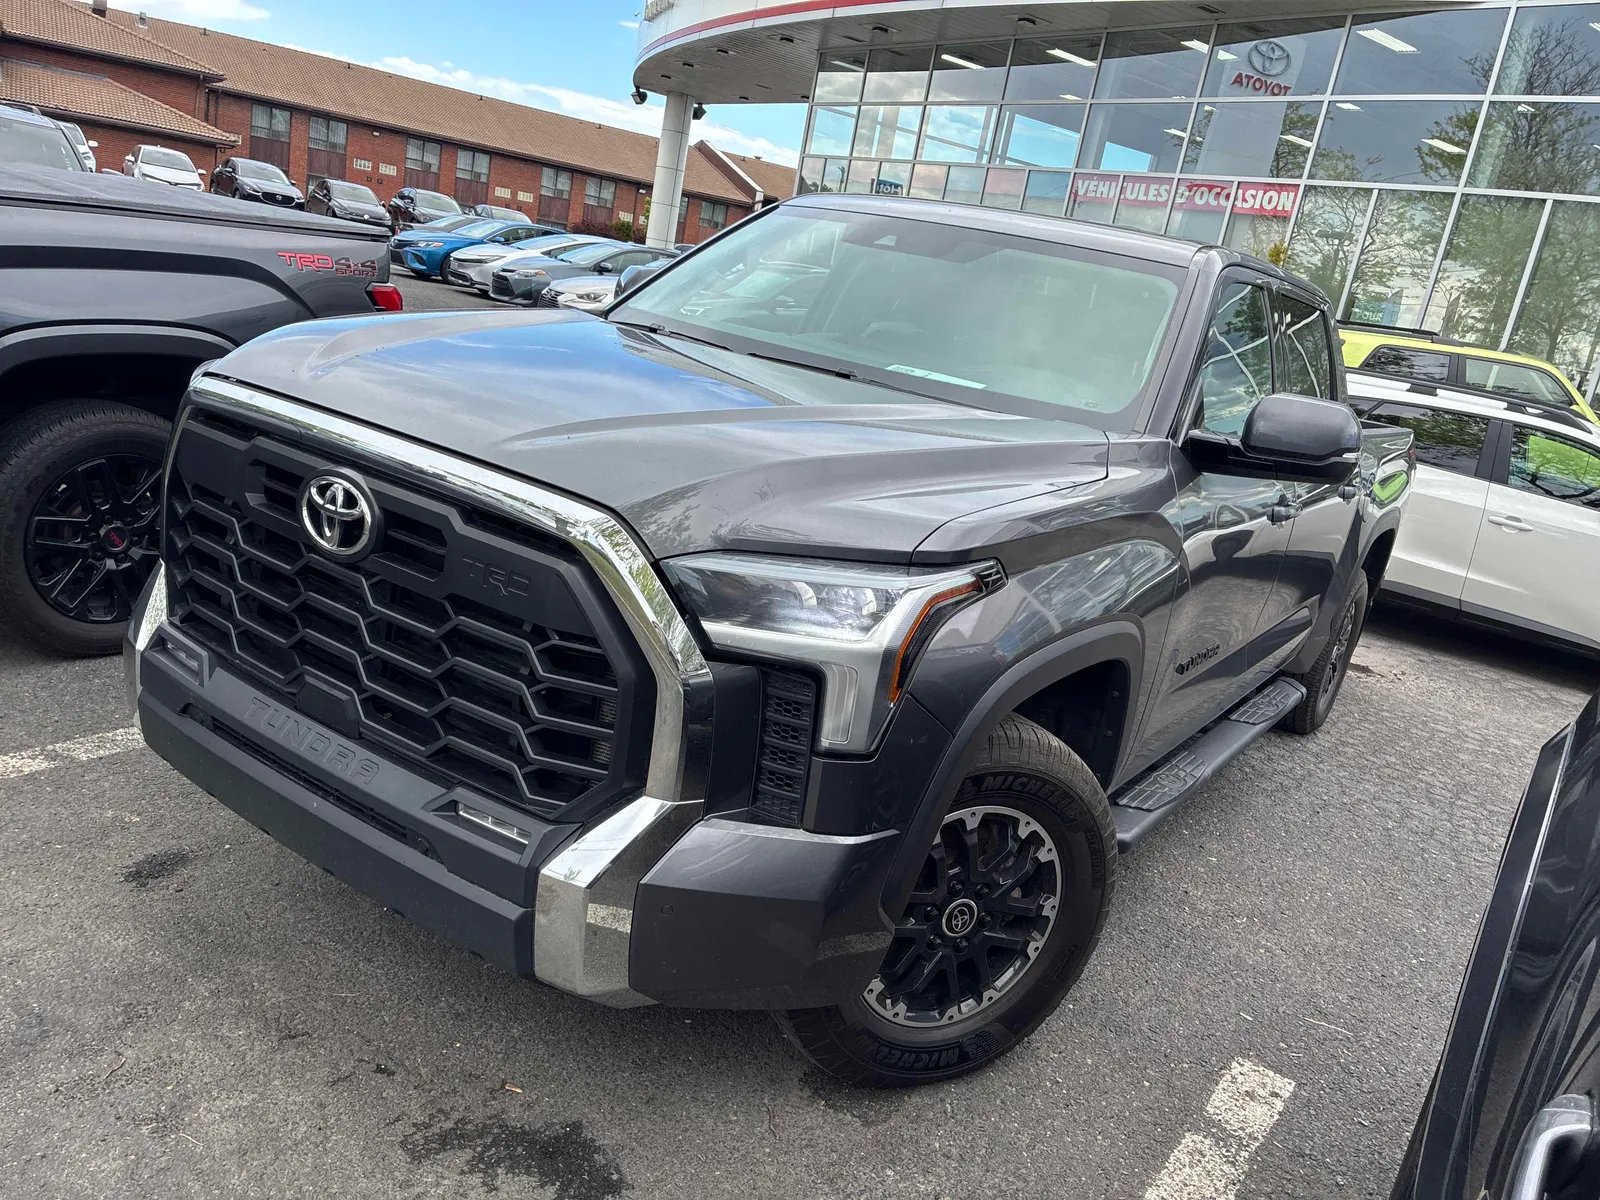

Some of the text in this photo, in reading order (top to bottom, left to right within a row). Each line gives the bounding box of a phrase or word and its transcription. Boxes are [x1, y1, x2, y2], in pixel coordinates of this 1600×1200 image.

[277, 251, 335, 272] TRD
[336, 268, 379, 278] SPORT
[462, 554, 532, 596] TRD
[1182, 642, 1220, 672] TUNDRA
[243, 696, 380, 786] TUNDRA
[980, 774, 1080, 822] MICHELIN
